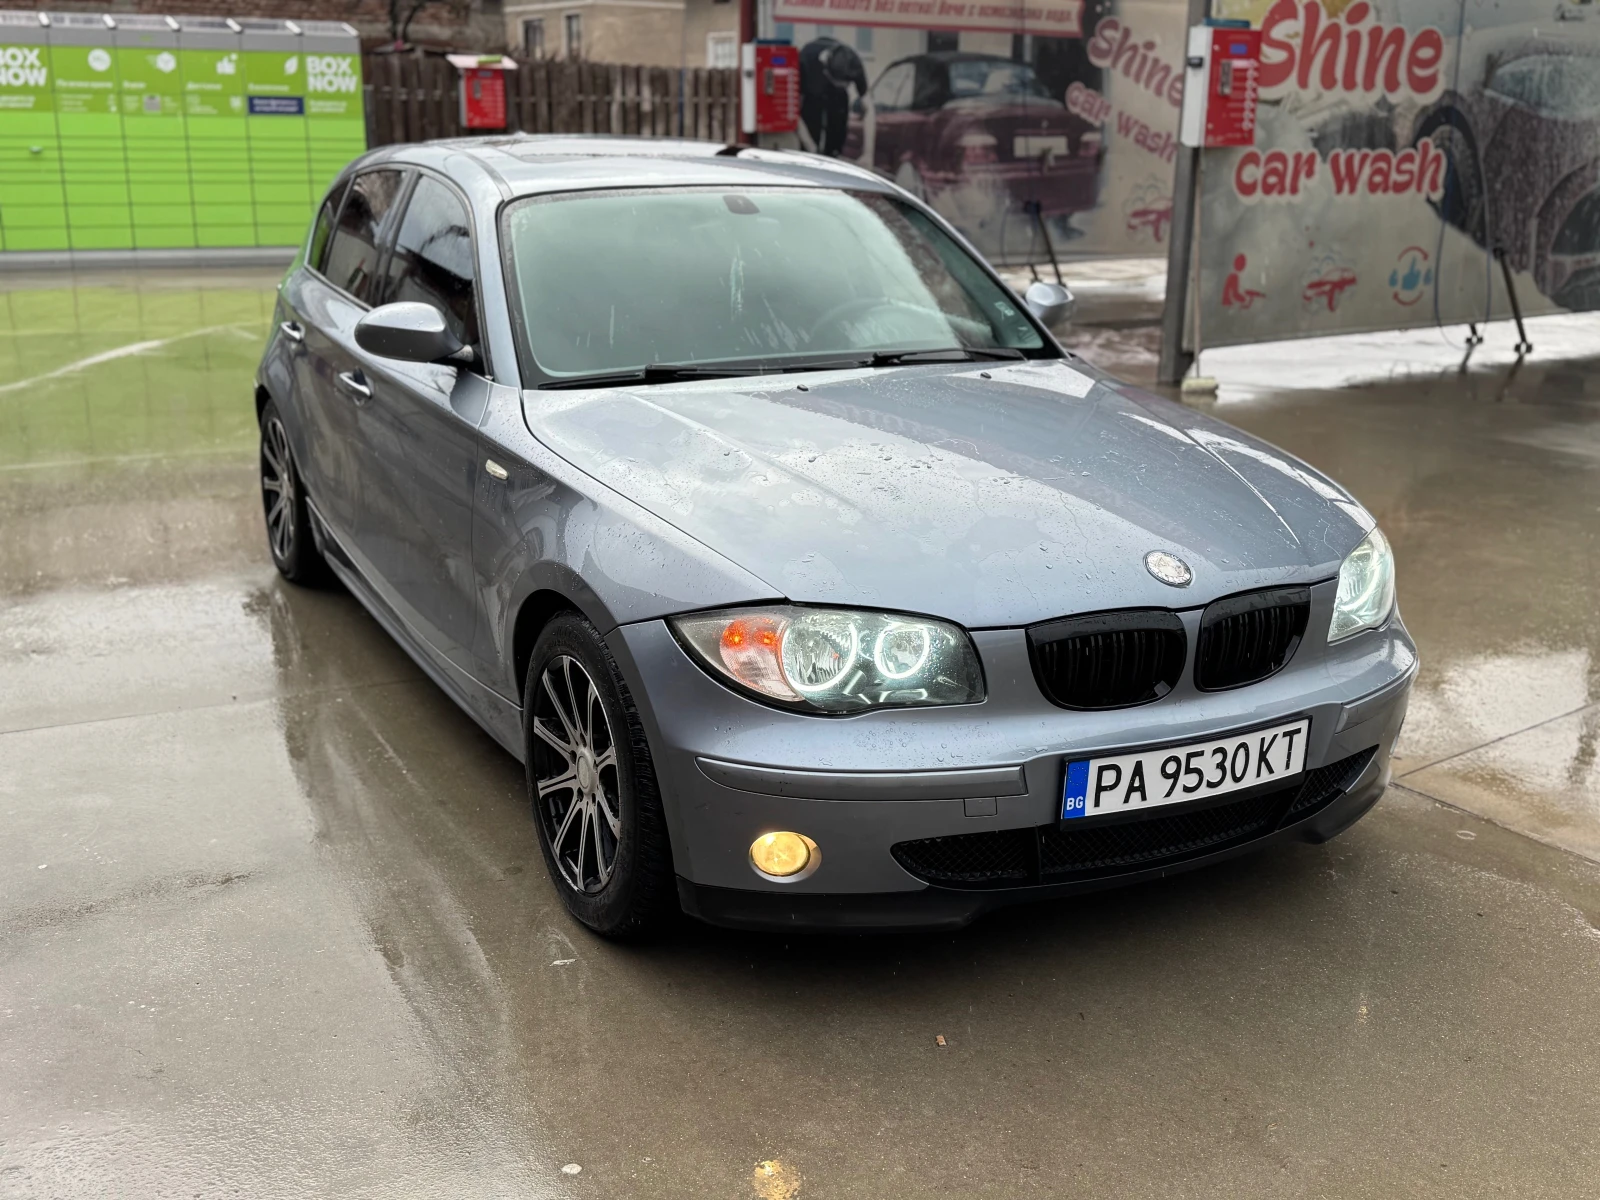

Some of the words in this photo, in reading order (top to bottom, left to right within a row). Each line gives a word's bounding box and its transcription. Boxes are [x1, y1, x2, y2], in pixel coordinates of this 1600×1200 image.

[306, 56, 352, 74] BOX
[1088, 18, 1184, 109] Shine
[1257, 0, 1443, 94] Shine
[307, 75, 357, 93] NOW
[1068, 83, 1112, 121] car
[1117, 111, 1178, 164] wash
[1235, 150, 1316, 197] car
[1330, 140, 1444, 195] wash
[1066, 796, 1083, 811] BG
[1094, 760, 1147, 808] PA
